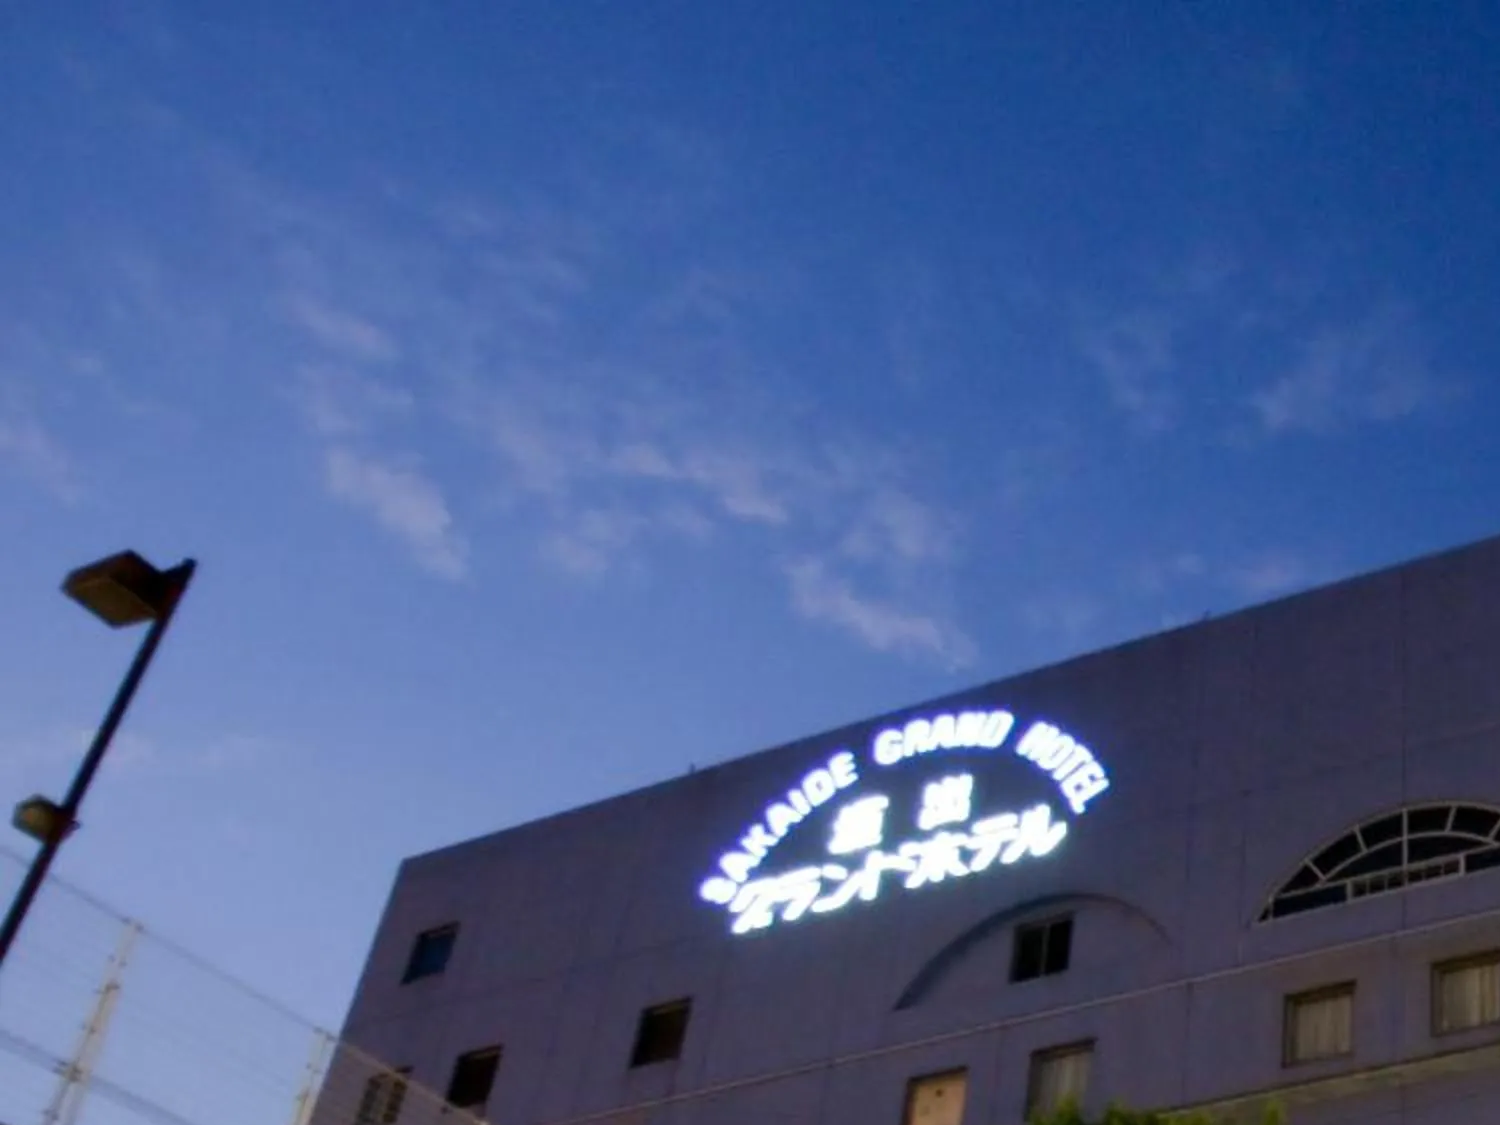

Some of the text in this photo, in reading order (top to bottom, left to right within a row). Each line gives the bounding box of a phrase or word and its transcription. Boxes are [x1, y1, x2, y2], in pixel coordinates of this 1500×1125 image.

[699, 709, 1110, 905] SAKAIDE GRAND HOTEL
